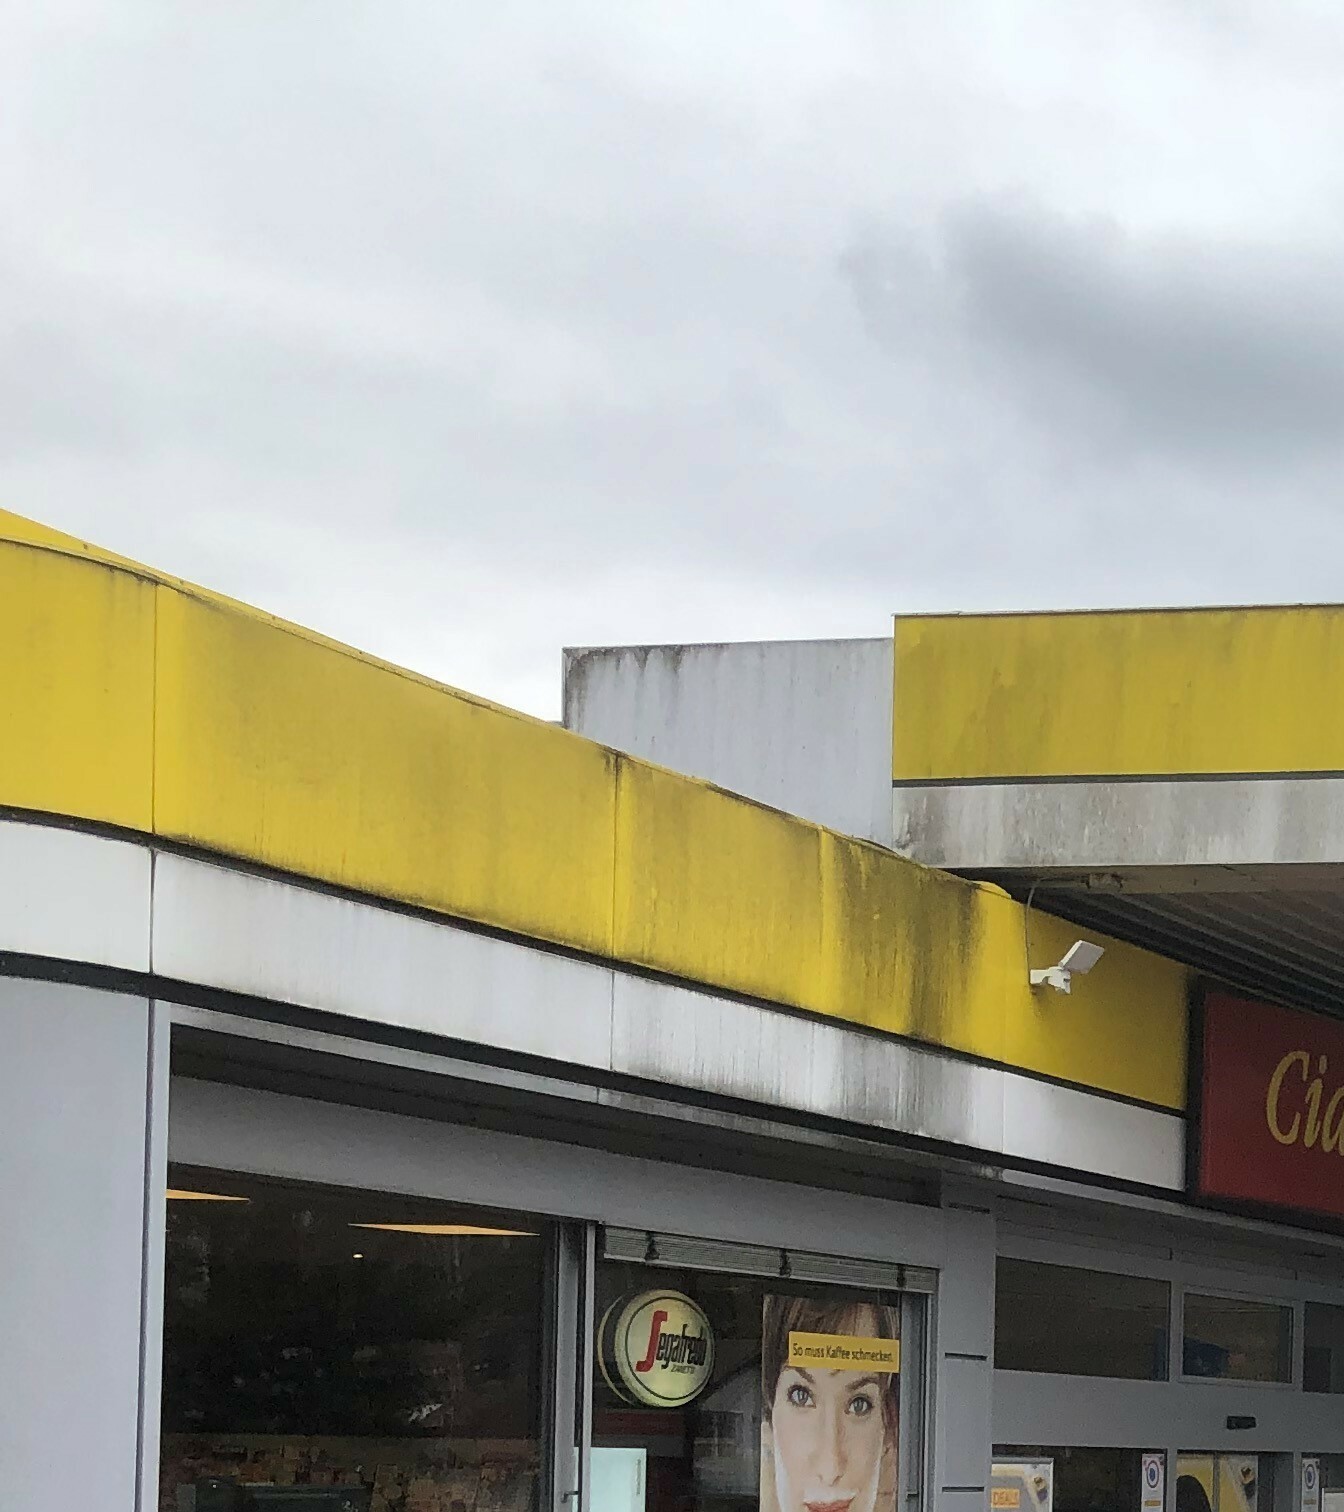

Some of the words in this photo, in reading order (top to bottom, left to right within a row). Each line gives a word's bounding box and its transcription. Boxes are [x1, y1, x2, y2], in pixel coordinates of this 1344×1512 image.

[635, 1310, 708, 1372] Segafredo
[792, 1343, 803, 1356] So
[804, 1345, 825, 1358] muss
[826, 1344, 850, 1360] Kaffee
